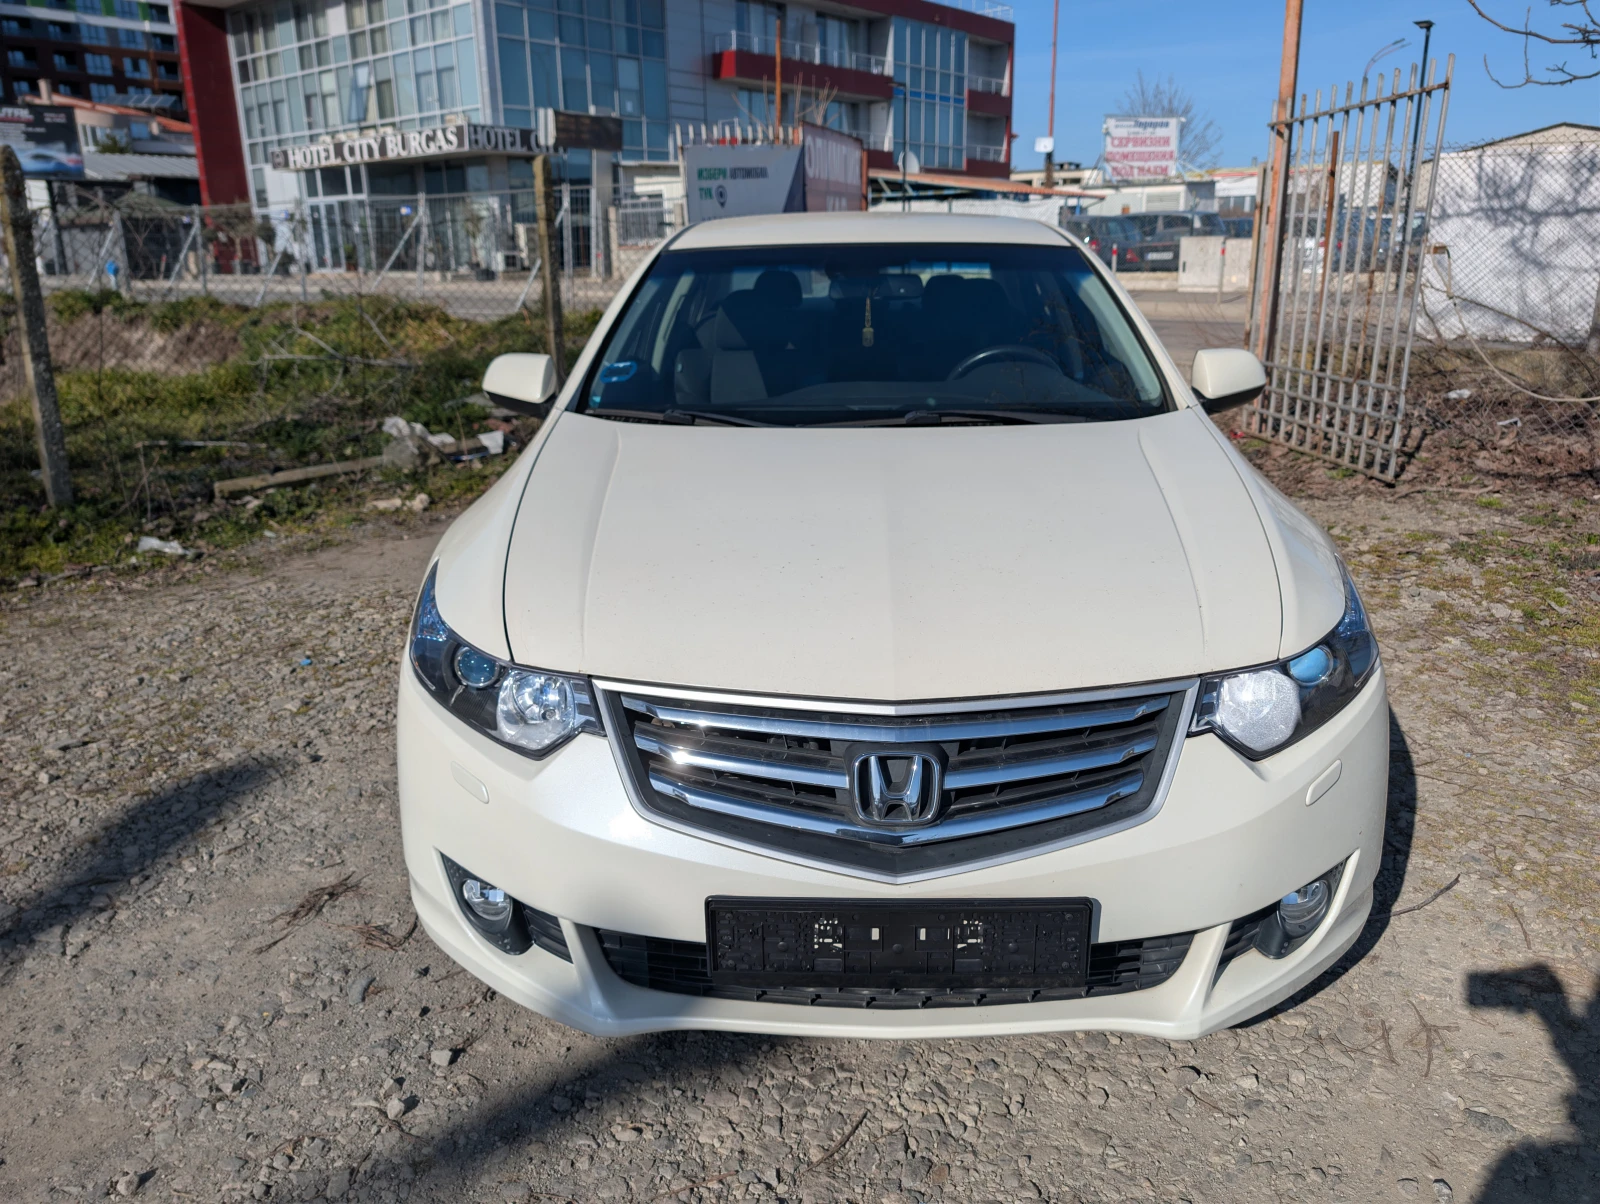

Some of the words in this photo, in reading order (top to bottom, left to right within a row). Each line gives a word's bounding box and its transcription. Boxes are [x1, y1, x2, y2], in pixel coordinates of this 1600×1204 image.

[287, 143, 344, 169] HOTEL
[343, 137, 381, 162] CITY
[387, 127, 458, 158] BURGAS
[469, 125, 527, 152] HOTEL
[697, 167, 727, 181] ИЗБЕРИ
[698, 187, 713, 200] ТУК
